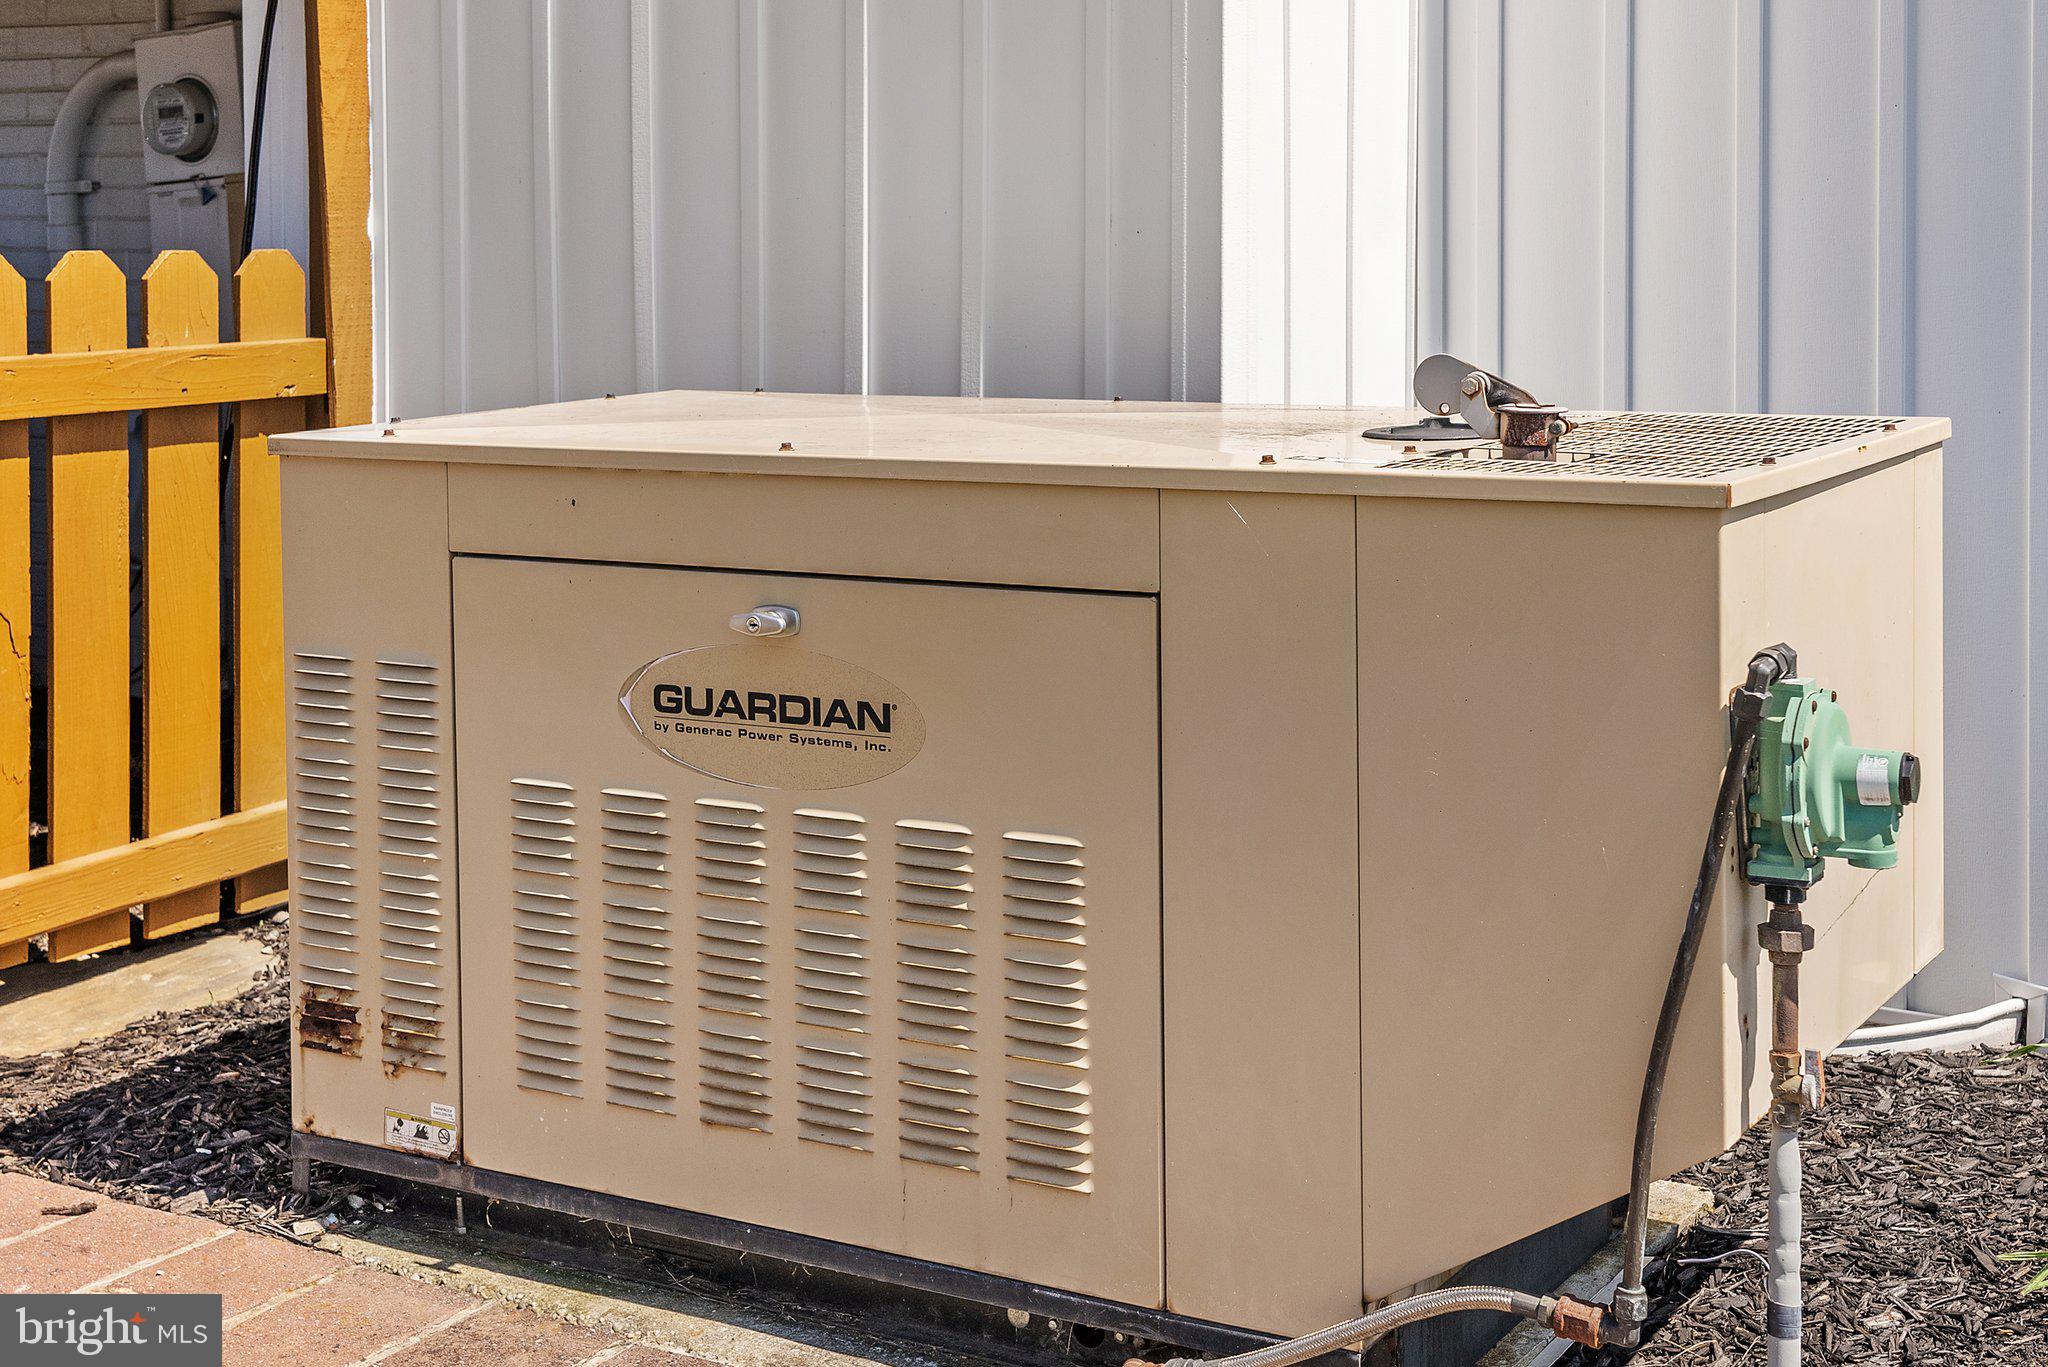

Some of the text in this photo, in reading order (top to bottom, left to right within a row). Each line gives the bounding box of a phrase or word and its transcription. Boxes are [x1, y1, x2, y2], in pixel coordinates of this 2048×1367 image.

[654, 721, 892, 752] by Generac Power Systems, Inc.
